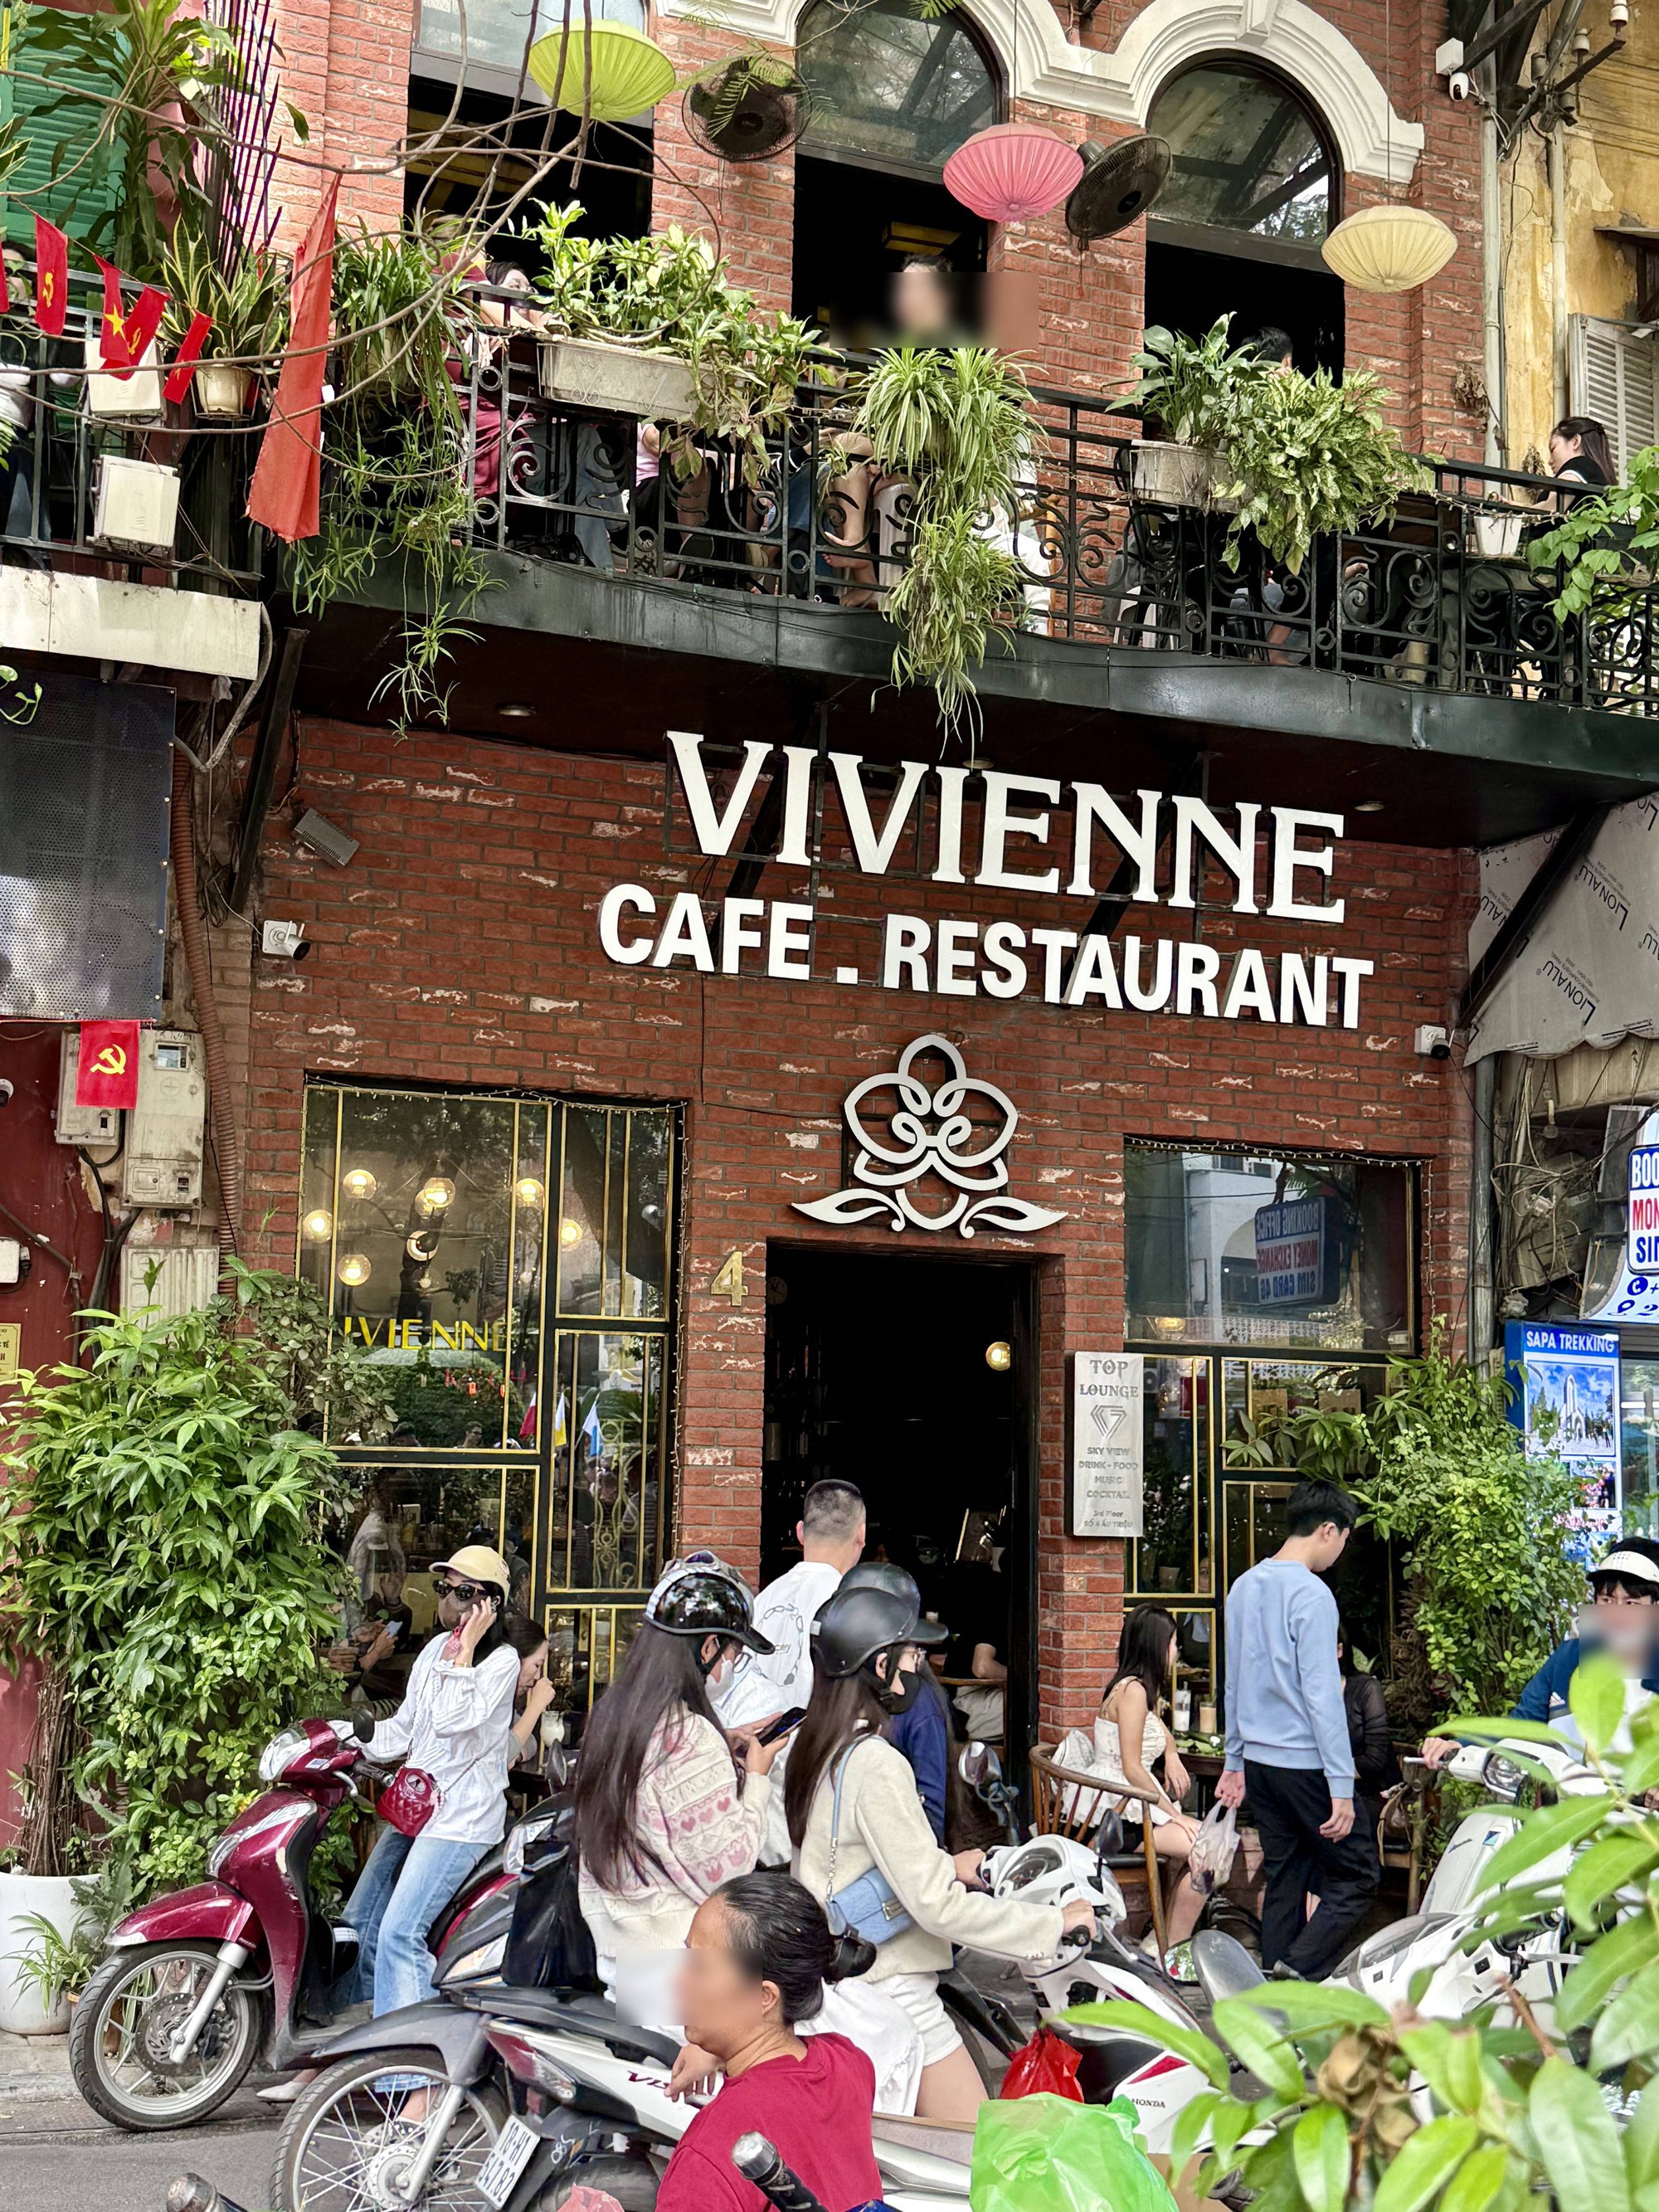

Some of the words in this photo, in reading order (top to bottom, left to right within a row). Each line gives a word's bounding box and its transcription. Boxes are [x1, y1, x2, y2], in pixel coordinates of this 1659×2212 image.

[666, 730, 1345, 923] VIVIENNE
[599, 884, 814, 981] CAFE
[883, 914, 1374, 1030] RESTAURANT
[711, 1250, 748, 1307] 4
[344, 1316, 507, 1352] IVIENNE
[1526, 1331, 1556, 1349] SAPA
[1559, 1333, 1615, 1353] TREKKING
[1090, 1359, 1128, 1380] TOP
[1079, 1384, 1139, 1400] LOUNGE
[1087, 1447, 1104, 1455] SKY
[1106, 1448, 1130, 1456] VIEW
[1078, 1460, 1106, 1469] DRINK
[1113, 1462, 1138, 1471] FOOD
[1131, 2098, 1166, 2108] HONDA
[499, 2121, 532, 2166] 18-H1
